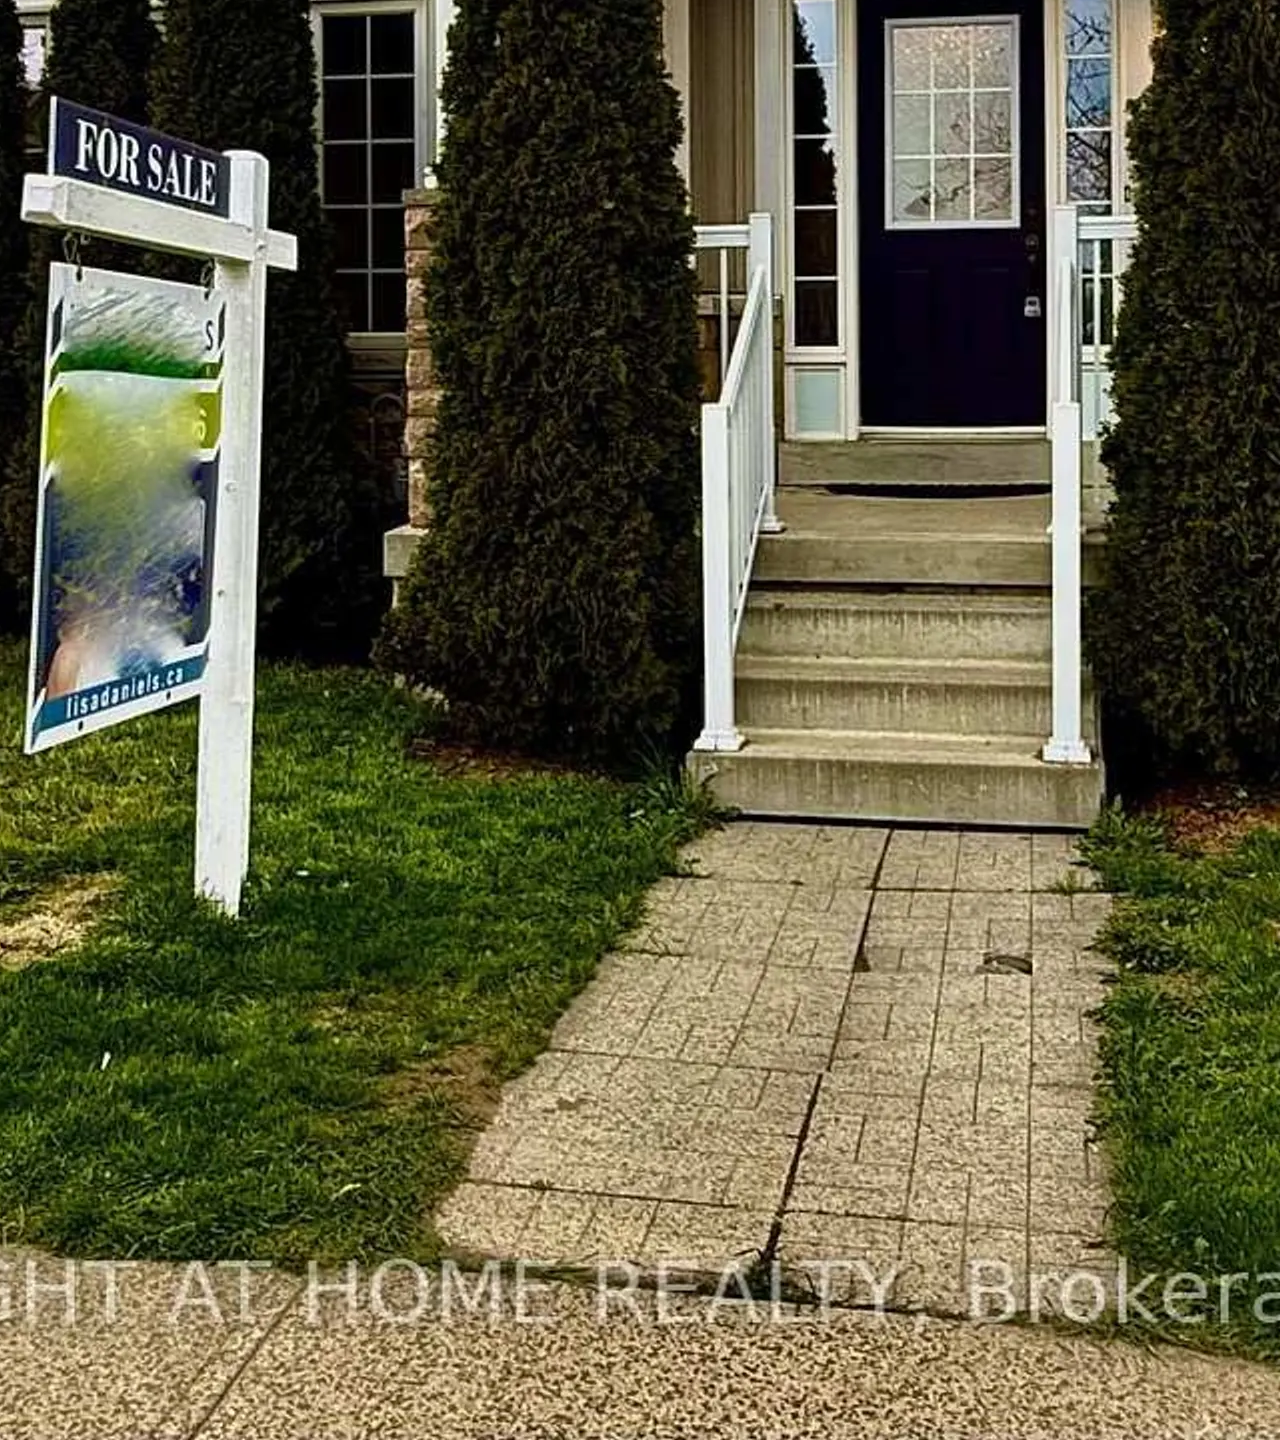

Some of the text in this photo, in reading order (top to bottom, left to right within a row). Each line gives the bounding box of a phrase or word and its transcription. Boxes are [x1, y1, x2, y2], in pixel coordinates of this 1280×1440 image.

[75, 119, 217, 206] FOR SALE
[65, 666, 184, 719] lisadaniels.ca
